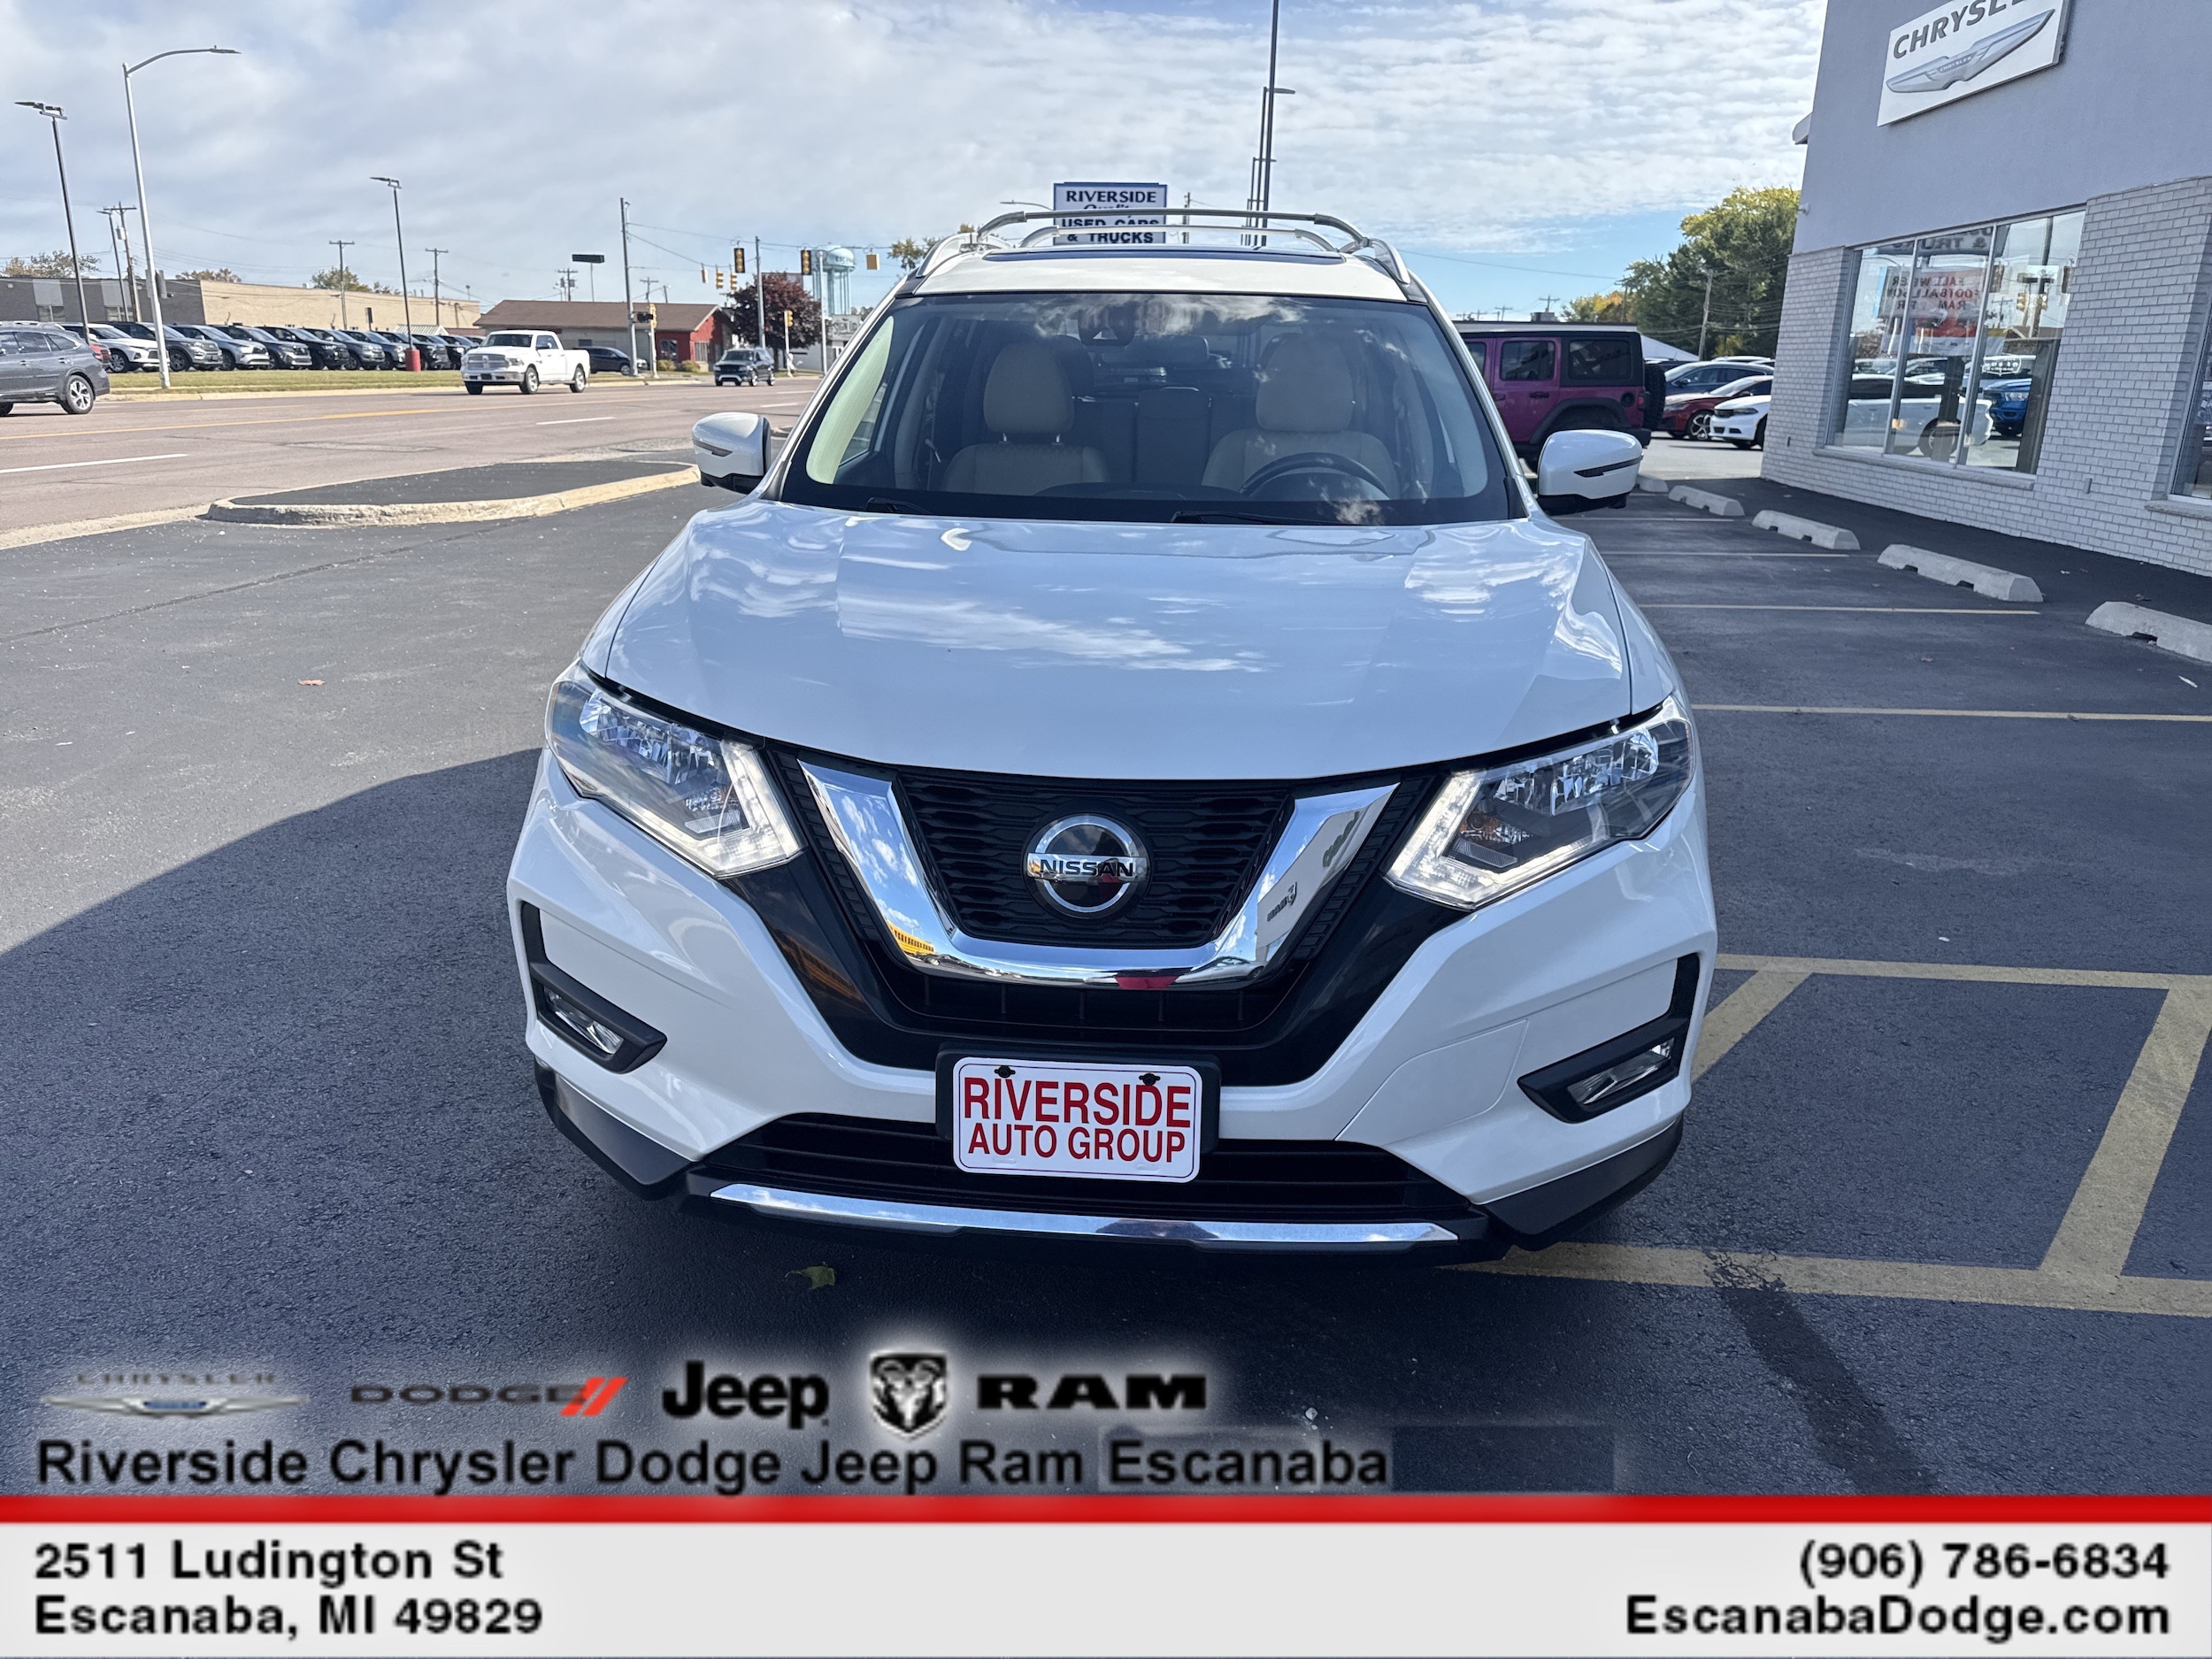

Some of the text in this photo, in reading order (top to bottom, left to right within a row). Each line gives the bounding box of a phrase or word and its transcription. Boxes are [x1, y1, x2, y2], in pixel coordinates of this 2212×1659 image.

[1066, 190, 1156, 204] RIVERSIDE
[1090, 232, 1154, 244] TRUCKS
[1041, 859, 1133, 877] NISSAN
[964, 1077, 1191, 1128] RIVERSIDE
[968, 1122, 1186, 1163] AUTO GROUP
